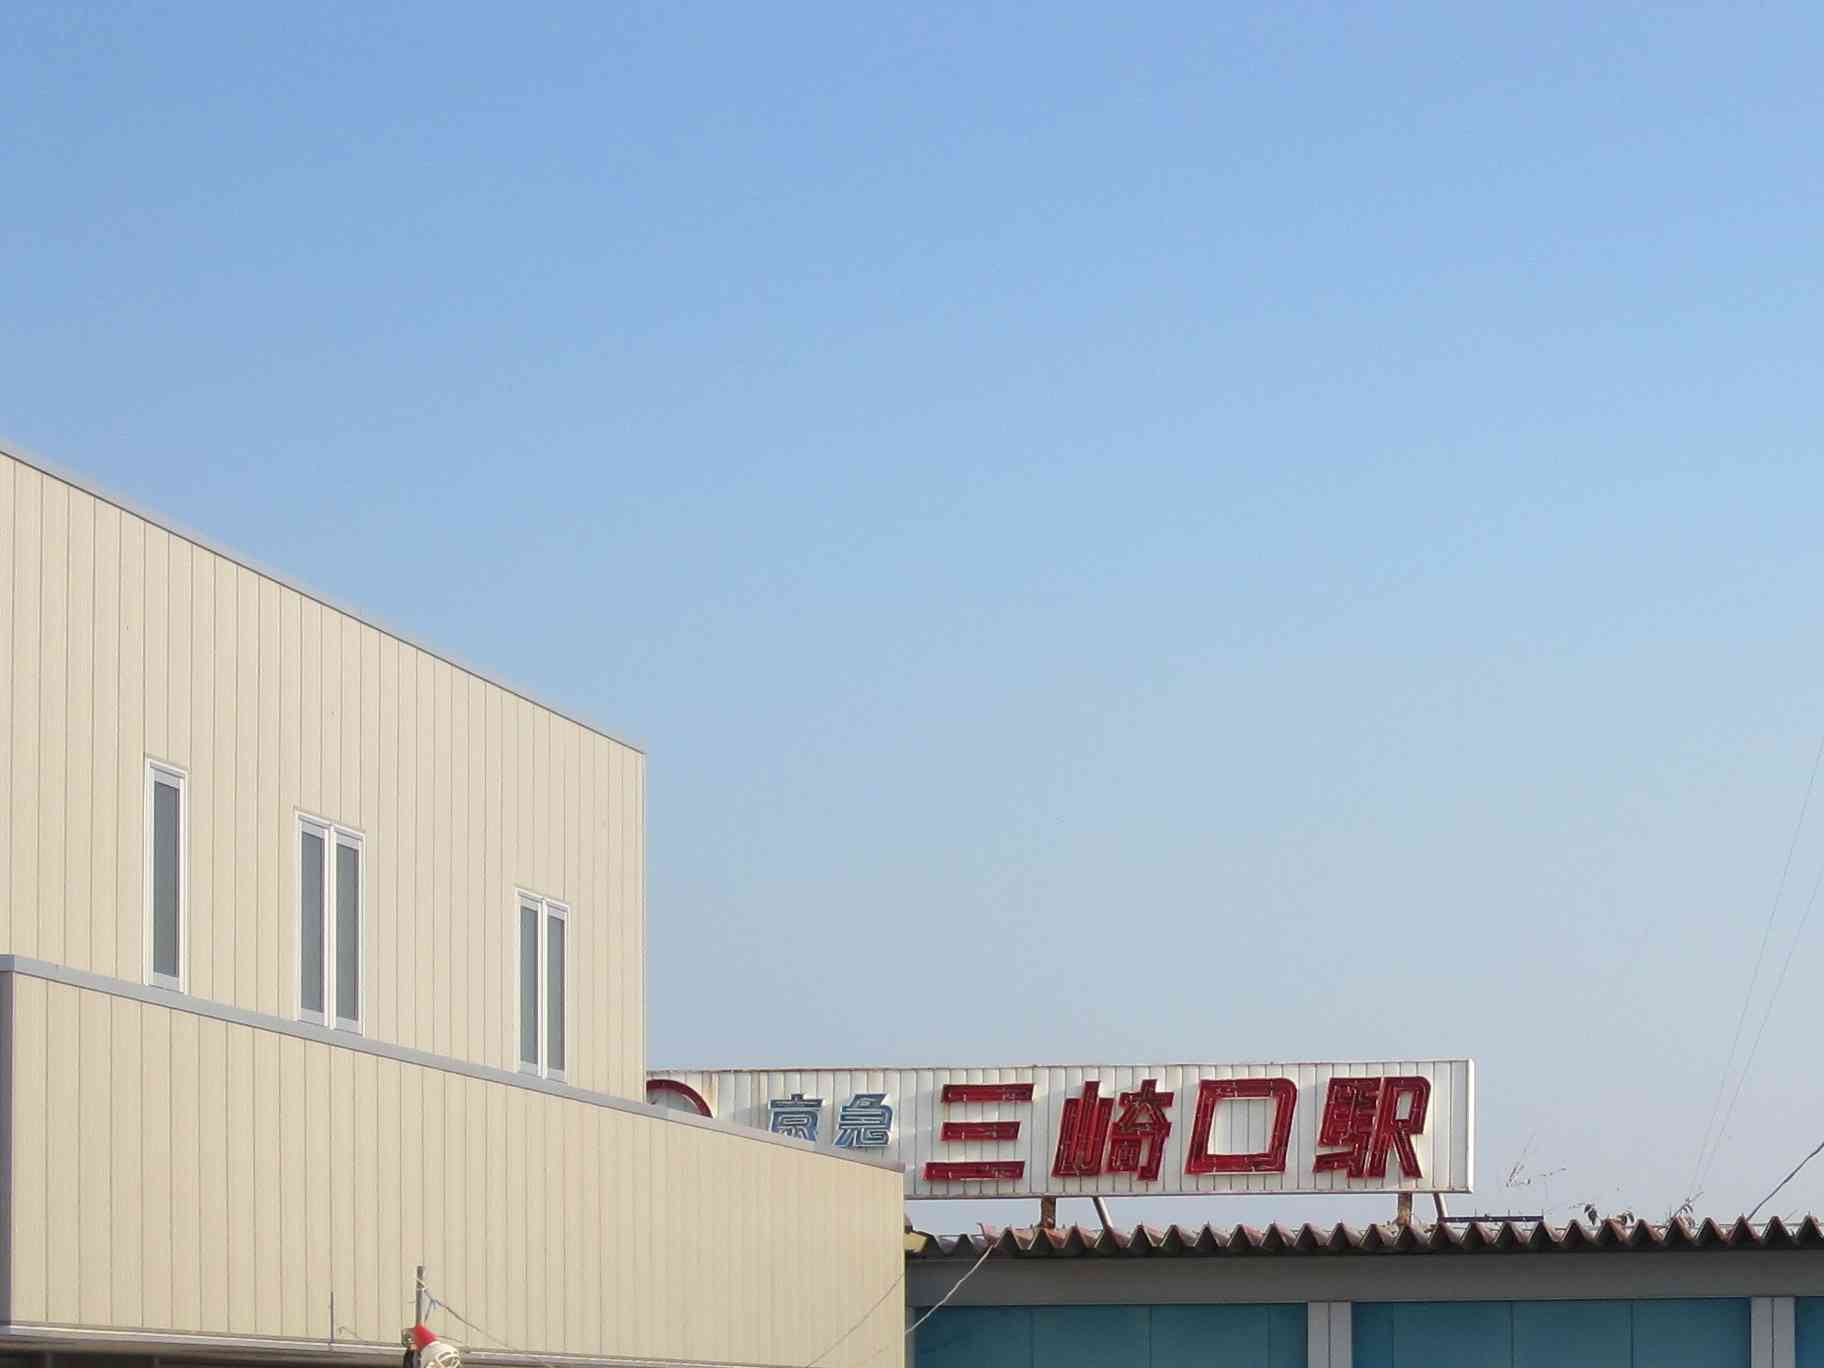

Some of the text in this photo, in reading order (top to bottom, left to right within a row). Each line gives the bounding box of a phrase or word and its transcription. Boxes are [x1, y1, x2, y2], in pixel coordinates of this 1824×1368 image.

[769, 1075, 1433, 1183] 京急 三崎口駅
